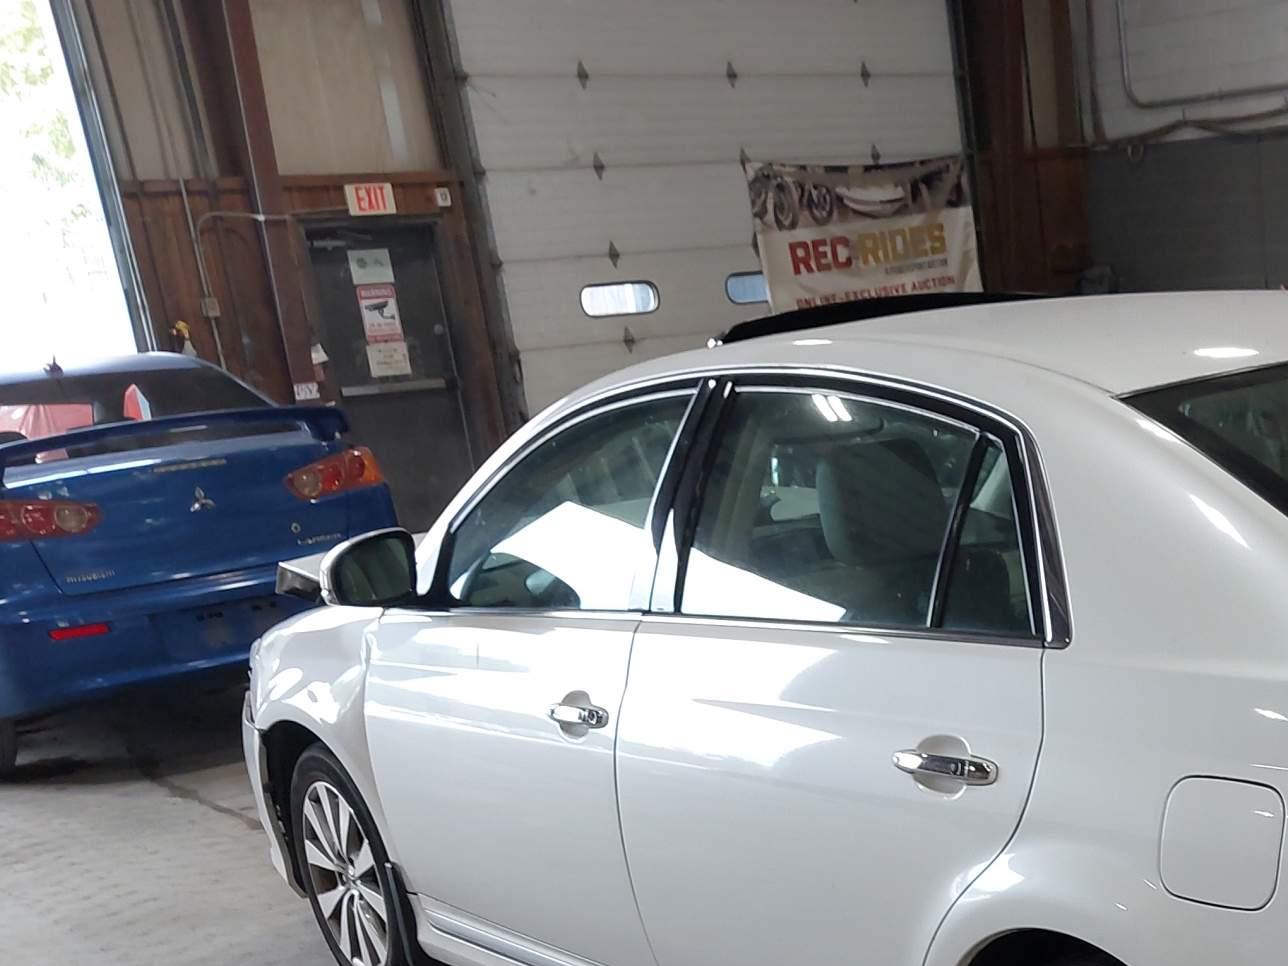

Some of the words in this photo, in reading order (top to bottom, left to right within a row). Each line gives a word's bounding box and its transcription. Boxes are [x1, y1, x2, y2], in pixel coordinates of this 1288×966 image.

[354, 185, 387, 212] EXIT
[788, 235, 853, 276] REC
[858, 223, 947, 266] RIDES
[911, 275, 956, 292] AUCTION
